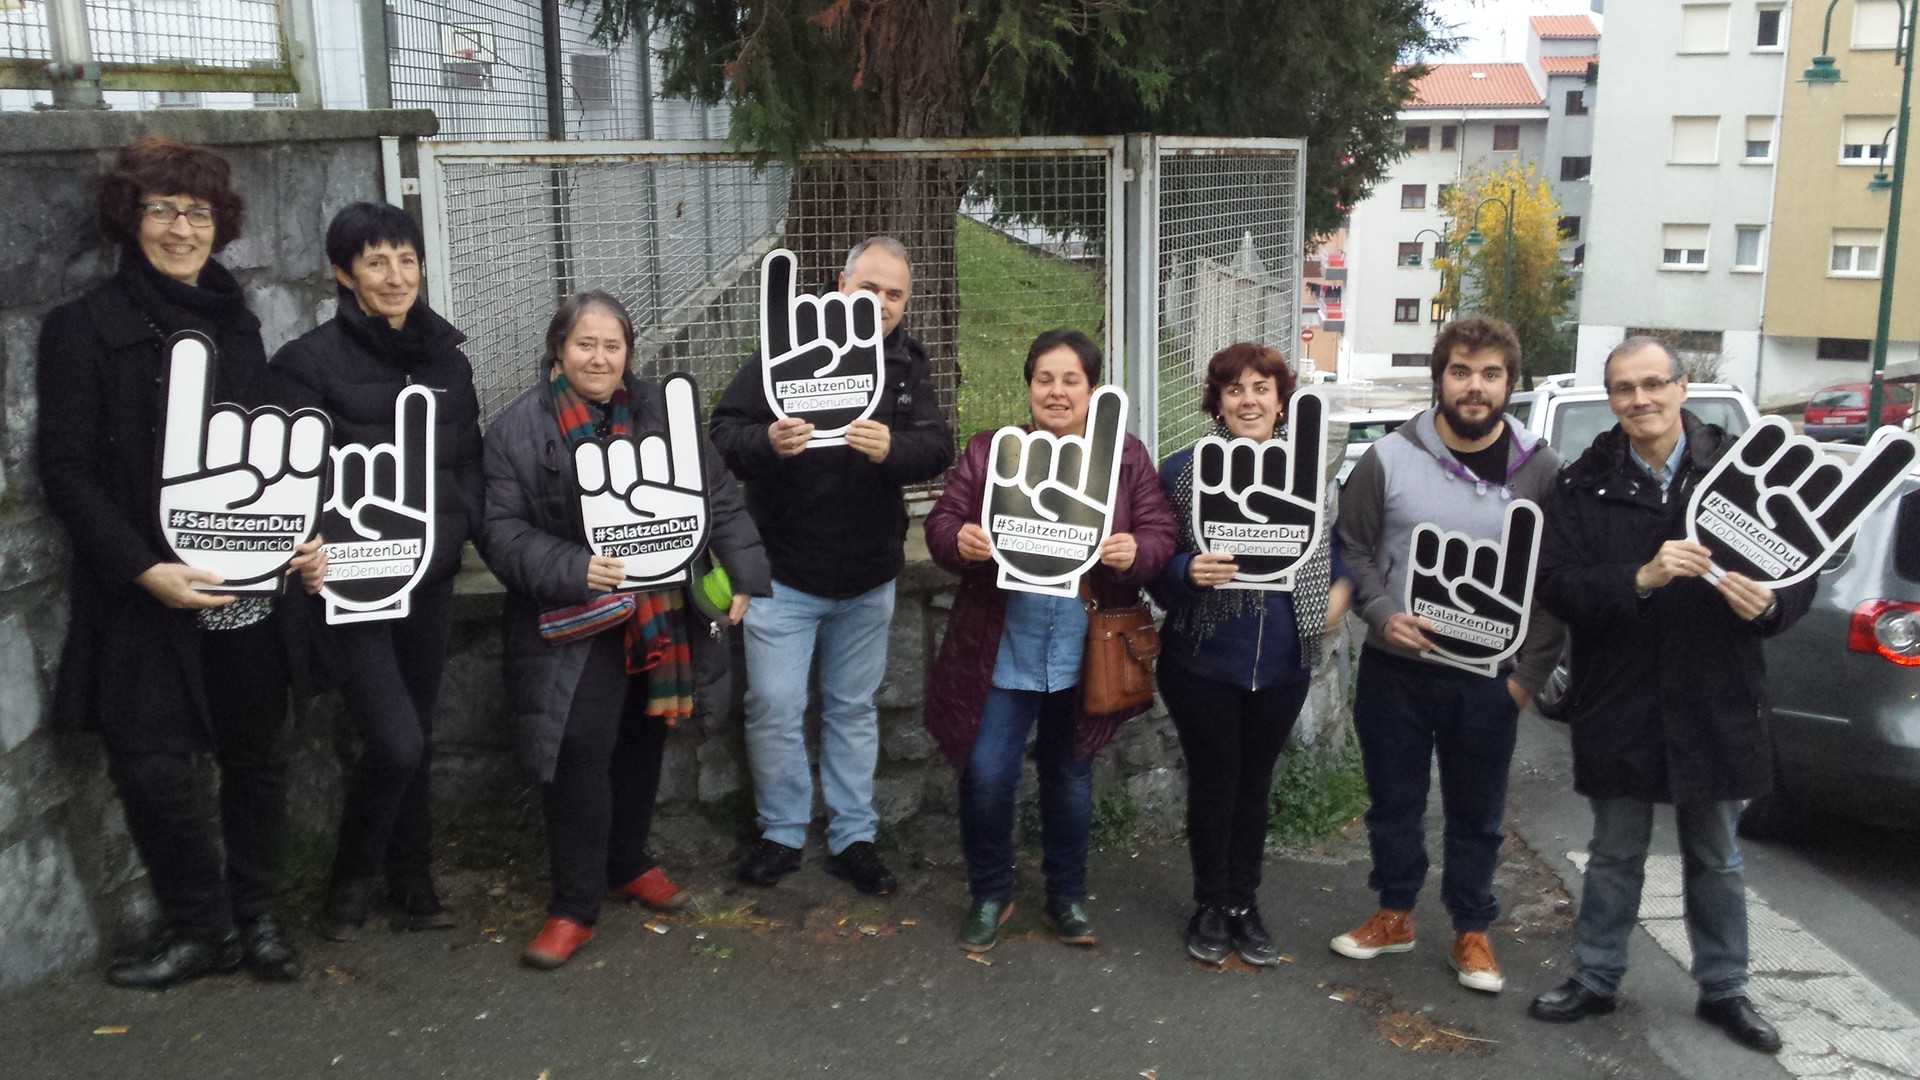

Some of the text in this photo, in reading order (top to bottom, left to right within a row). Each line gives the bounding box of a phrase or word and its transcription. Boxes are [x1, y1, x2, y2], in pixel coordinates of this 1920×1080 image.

[780, 377, 870, 395] #SalatzenDut
[787, 396, 866, 411] #YoDenuncio
[171, 511, 303, 532] #SalatzenDut
[595, 517, 697, 542] #SalatzenDut
[996, 518, 1094, 543] #SalatzenDut
[1207, 524, 1306, 540] #SalatzenDut
[1707, 496, 1802, 568] #SalatzenDut
[177, 534, 293, 551] #YoDenuncio
[321, 543, 418, 560] SalatzenDut
[604, 536, 692, 557] #YoDenuncio
[1000, 537, 1085, 558] #YoDenuncio
[1212, 542, 1299, 555] #YoDenuncio
[1701, 515, 1781, 576] #YoDenuncio
[1417, 601, 1511, 637] #SalatzenDut
